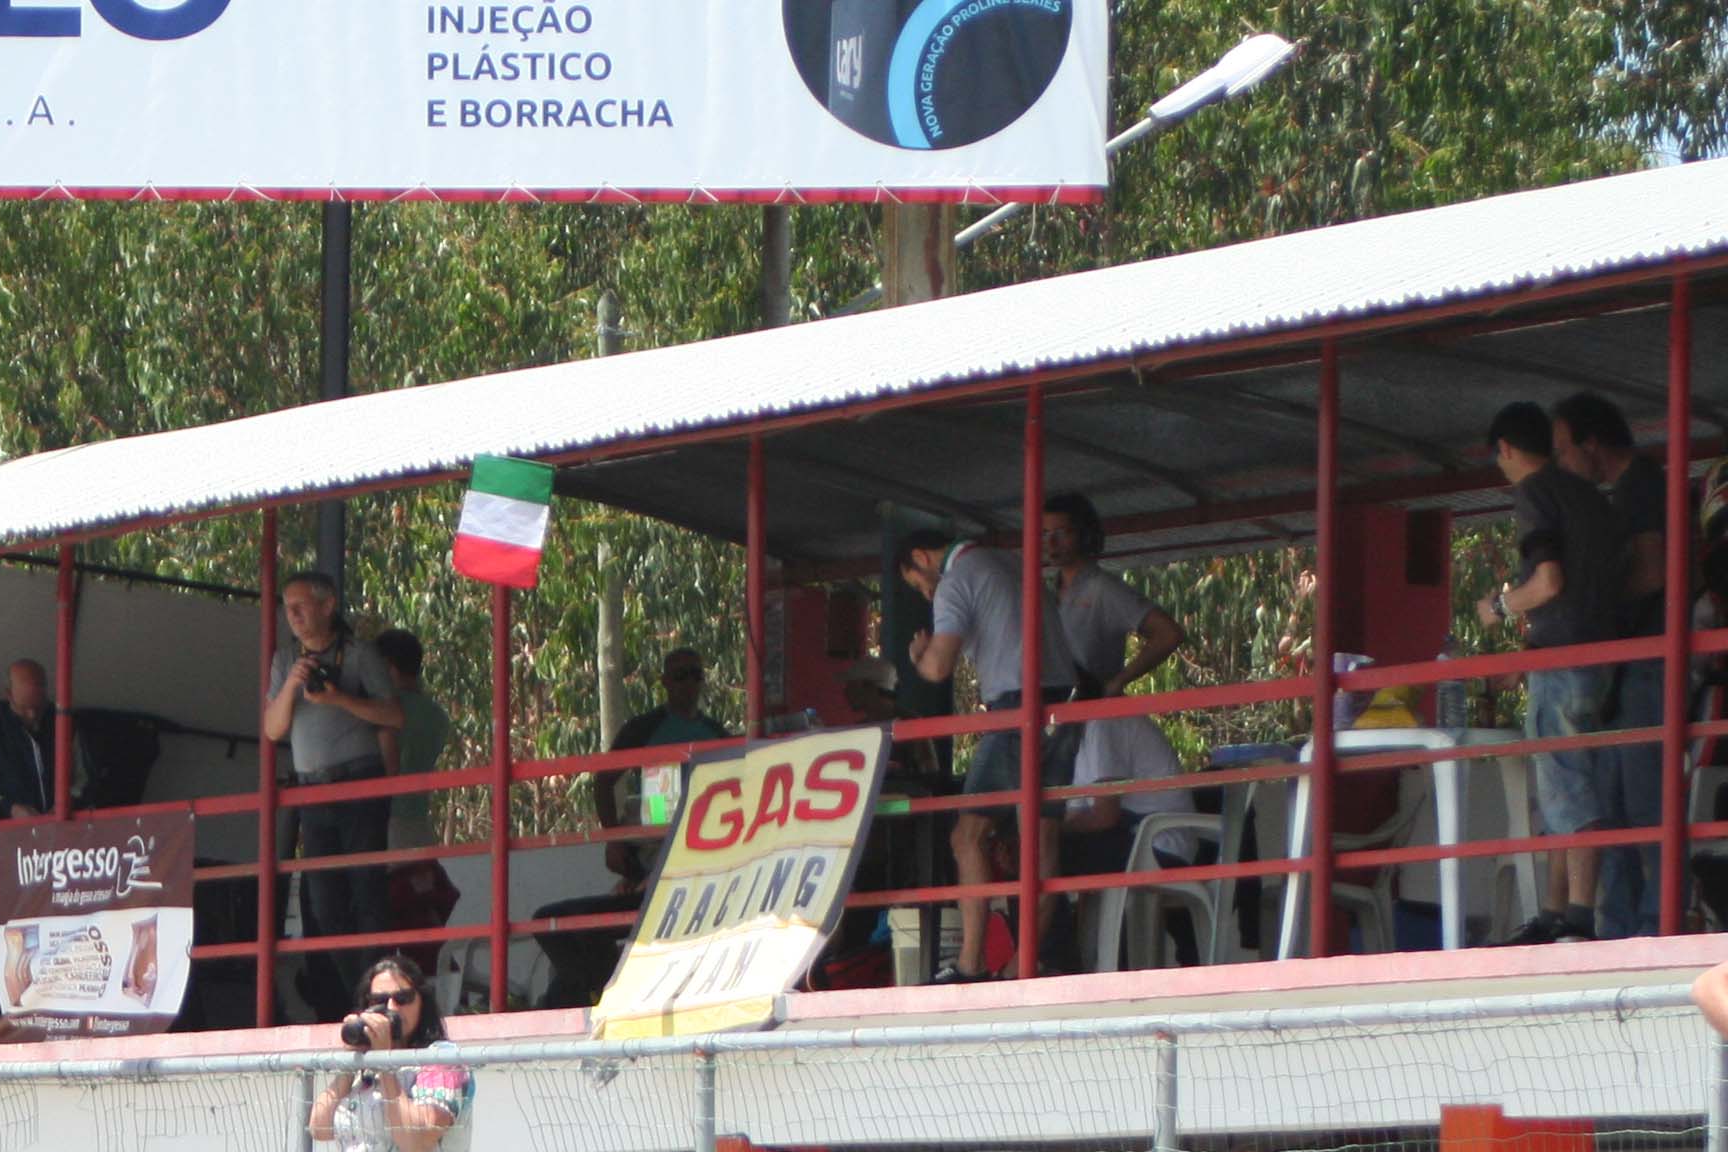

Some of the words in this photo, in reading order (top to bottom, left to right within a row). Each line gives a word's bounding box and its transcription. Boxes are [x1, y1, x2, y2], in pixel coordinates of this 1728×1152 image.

[427, 0, 593, 42] INJEÇÃO
[427, 45, 612, 81] PLÁSTICO
[920, 24, 954, 93] GERAÇÃO
[427, 100, 446, 128] E
[460, 100, 674, 128] BORRACHA
[921, 95, 943, 139] NOVA
[685, 749, 866, 851] GAS
[656, 855, 826, 939] RACING
